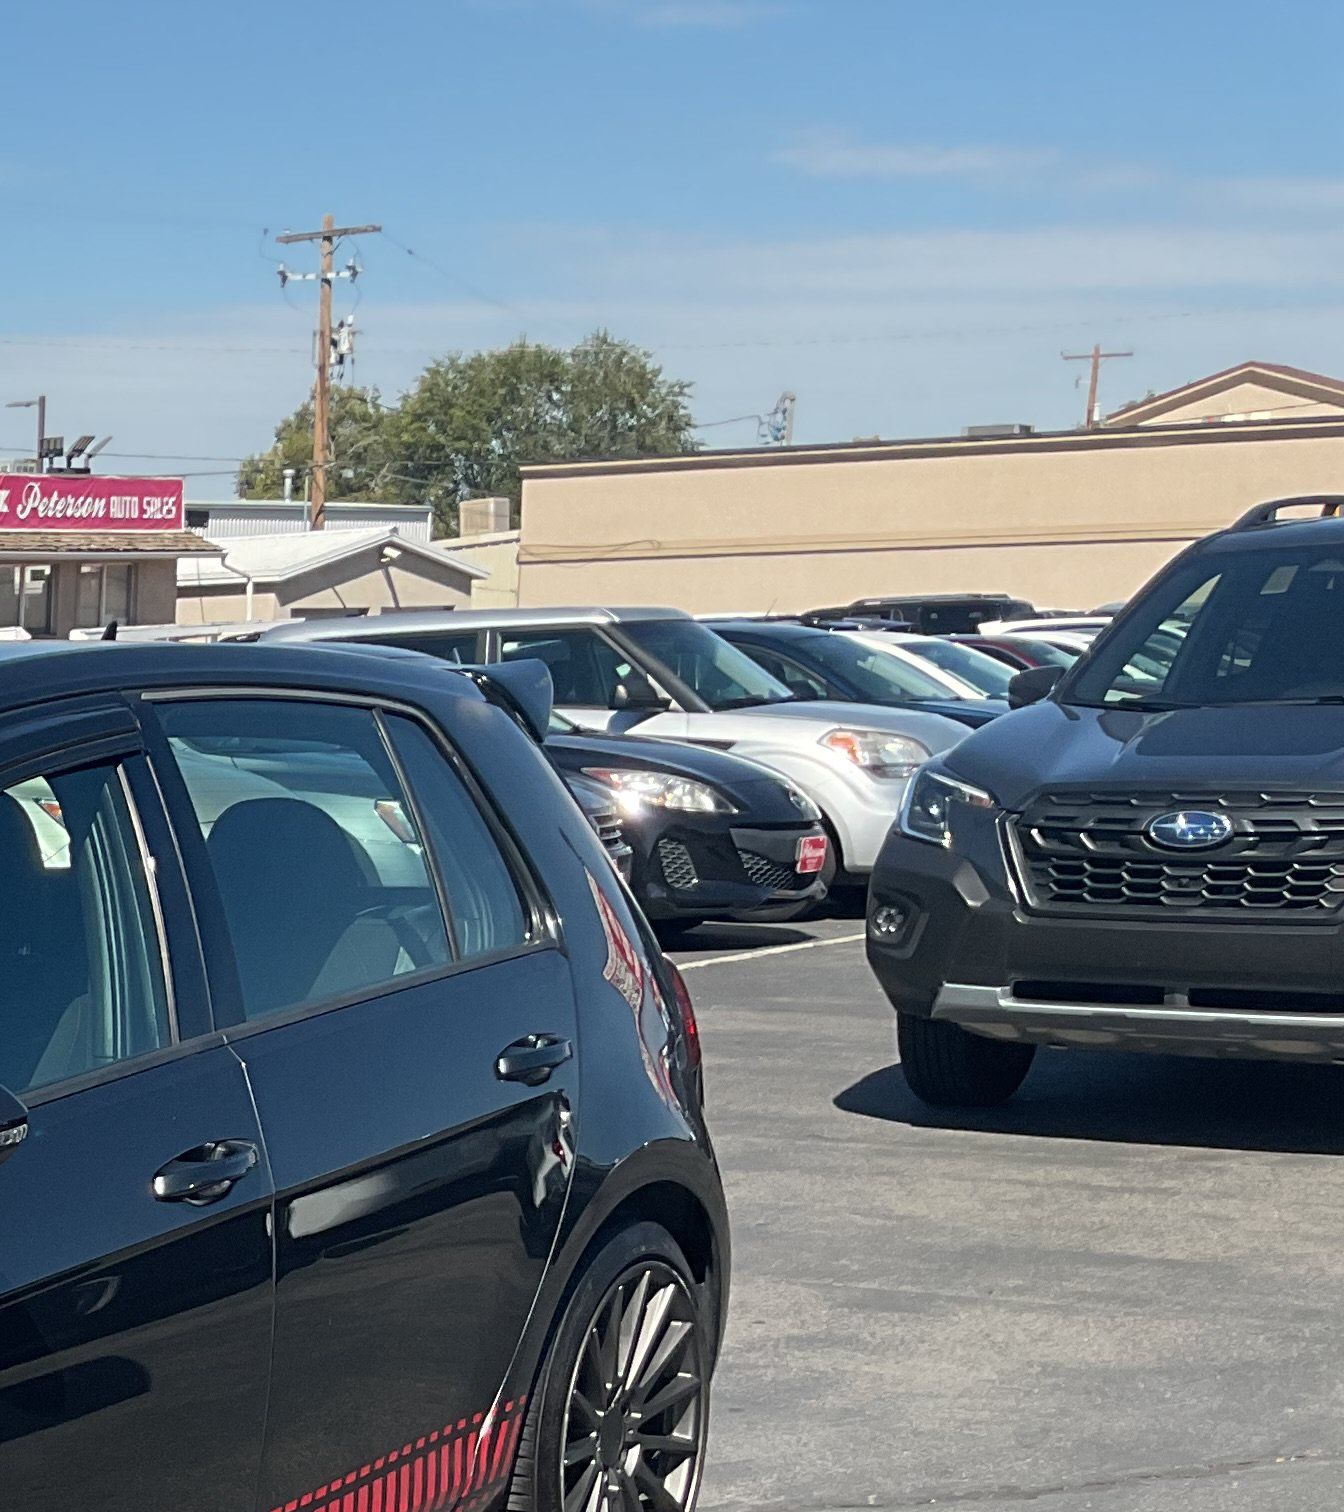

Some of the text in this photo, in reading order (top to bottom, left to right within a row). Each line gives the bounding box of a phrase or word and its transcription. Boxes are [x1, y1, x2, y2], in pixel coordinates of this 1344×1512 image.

[16, 481, 177, 520] Peterson AUTO SALES
